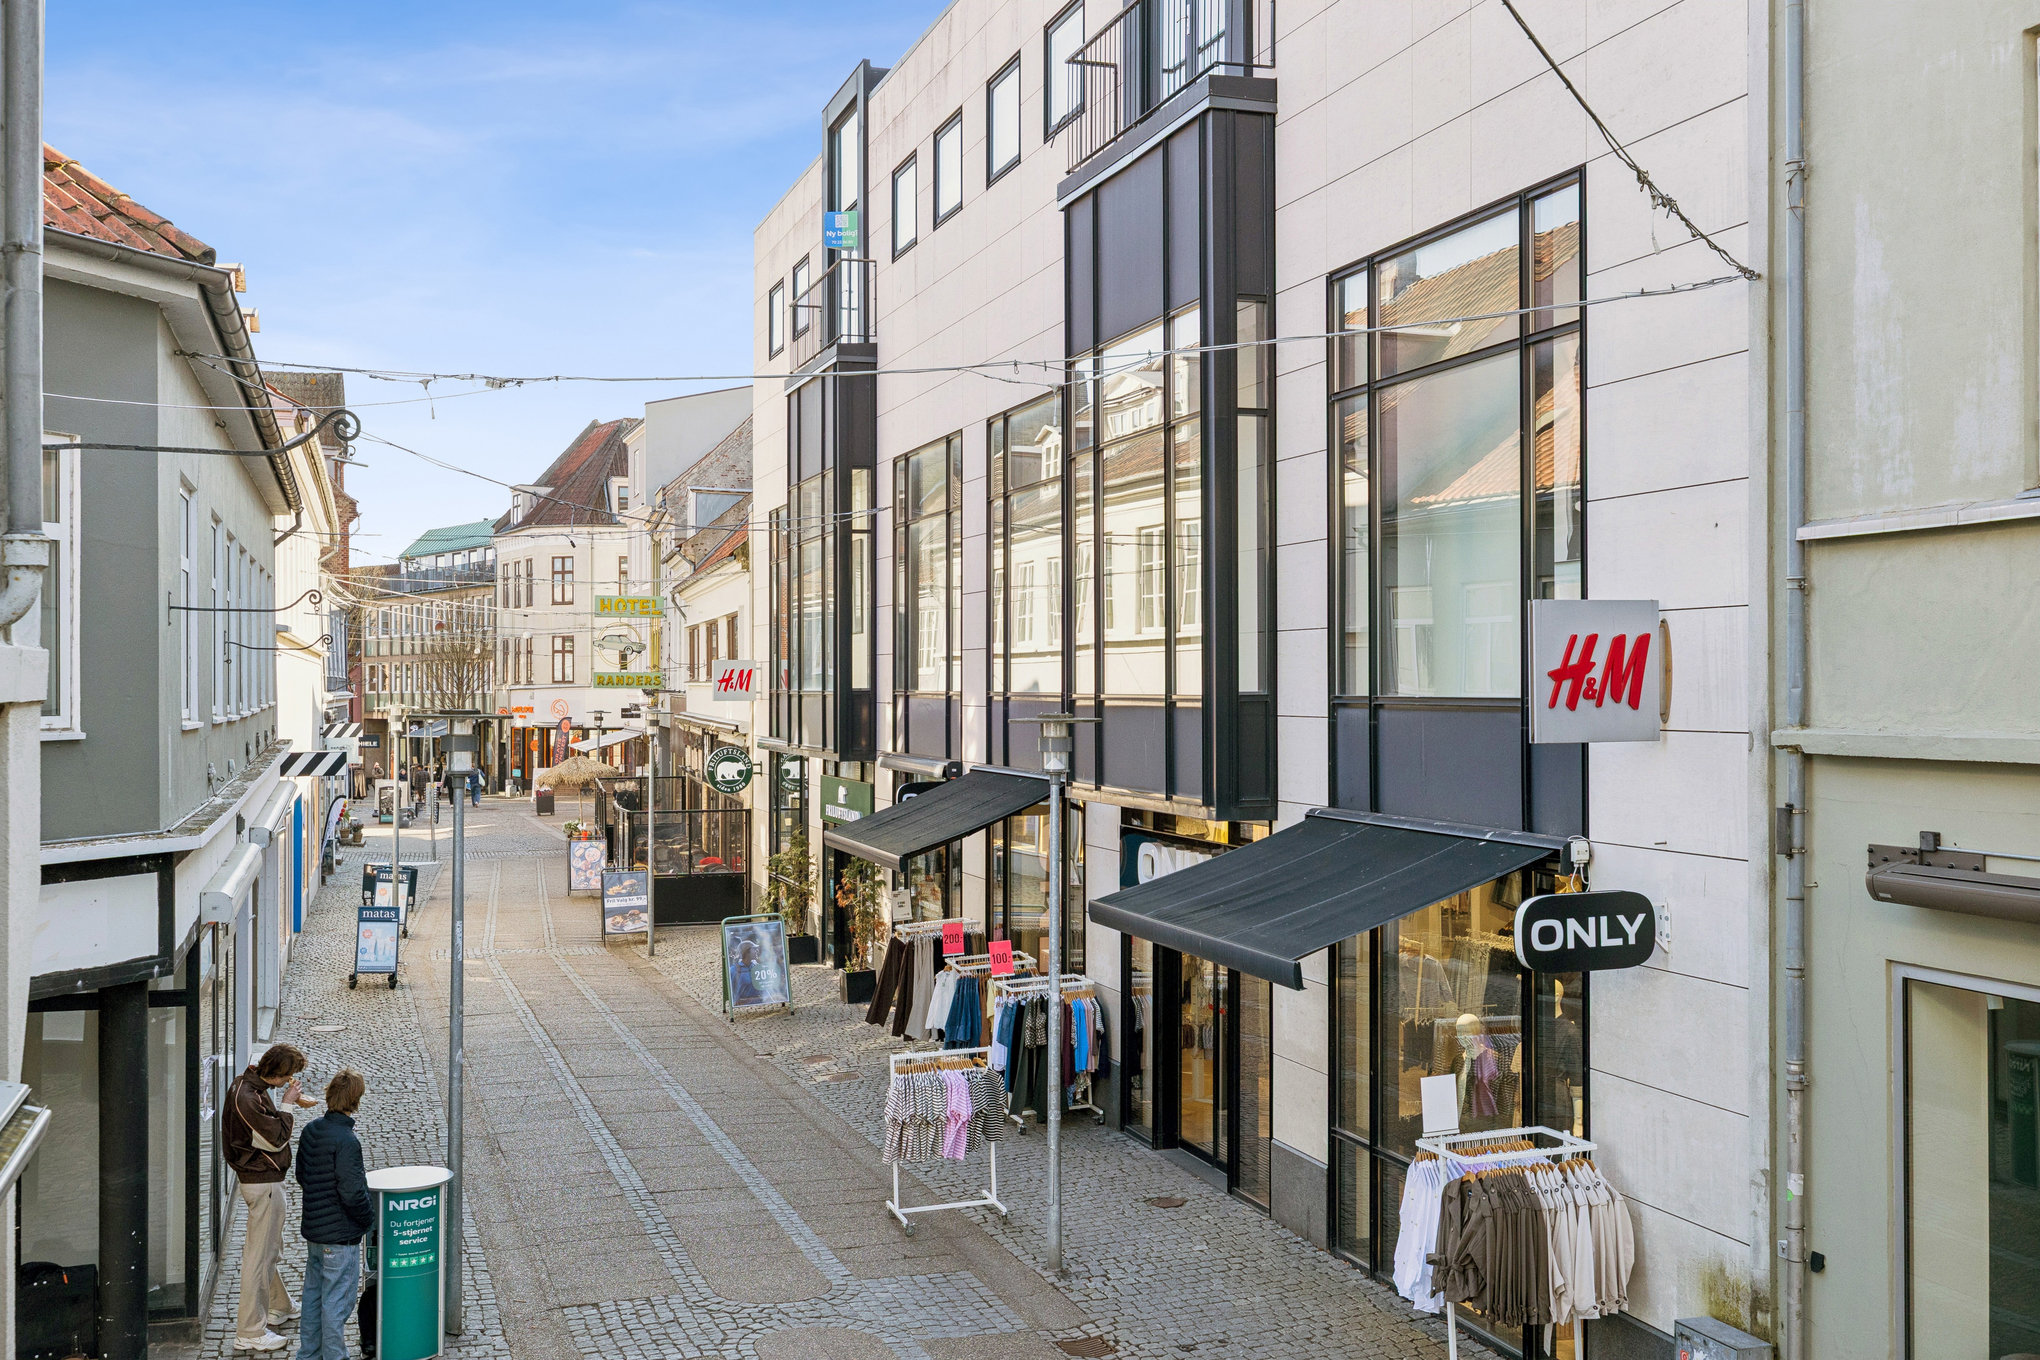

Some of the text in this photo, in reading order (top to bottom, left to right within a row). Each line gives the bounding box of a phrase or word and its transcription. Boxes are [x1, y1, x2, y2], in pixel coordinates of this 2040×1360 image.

[826, 230, 836, 238] Ny
[600, 597, 662, 615] HOTEL
[1547, 632, 1651, 711] H&M
[596, 675, 661, 687] RANDERS
[717, 668, 753, 692] H&M
[708, 748, 752, 771] FRILUFTSLAND
[732, 781, 746, 792] 1980
[362, 910, 396, 918] matas
[1530, 913, 1646, 952] ONLY
[754, 969, 777, 980] 20%
[390, 1216, 436, 1228] Du fortjener
[393, 1226, 433, 1237] 5-stjernet
[399, 1237, 428, 1245] service
